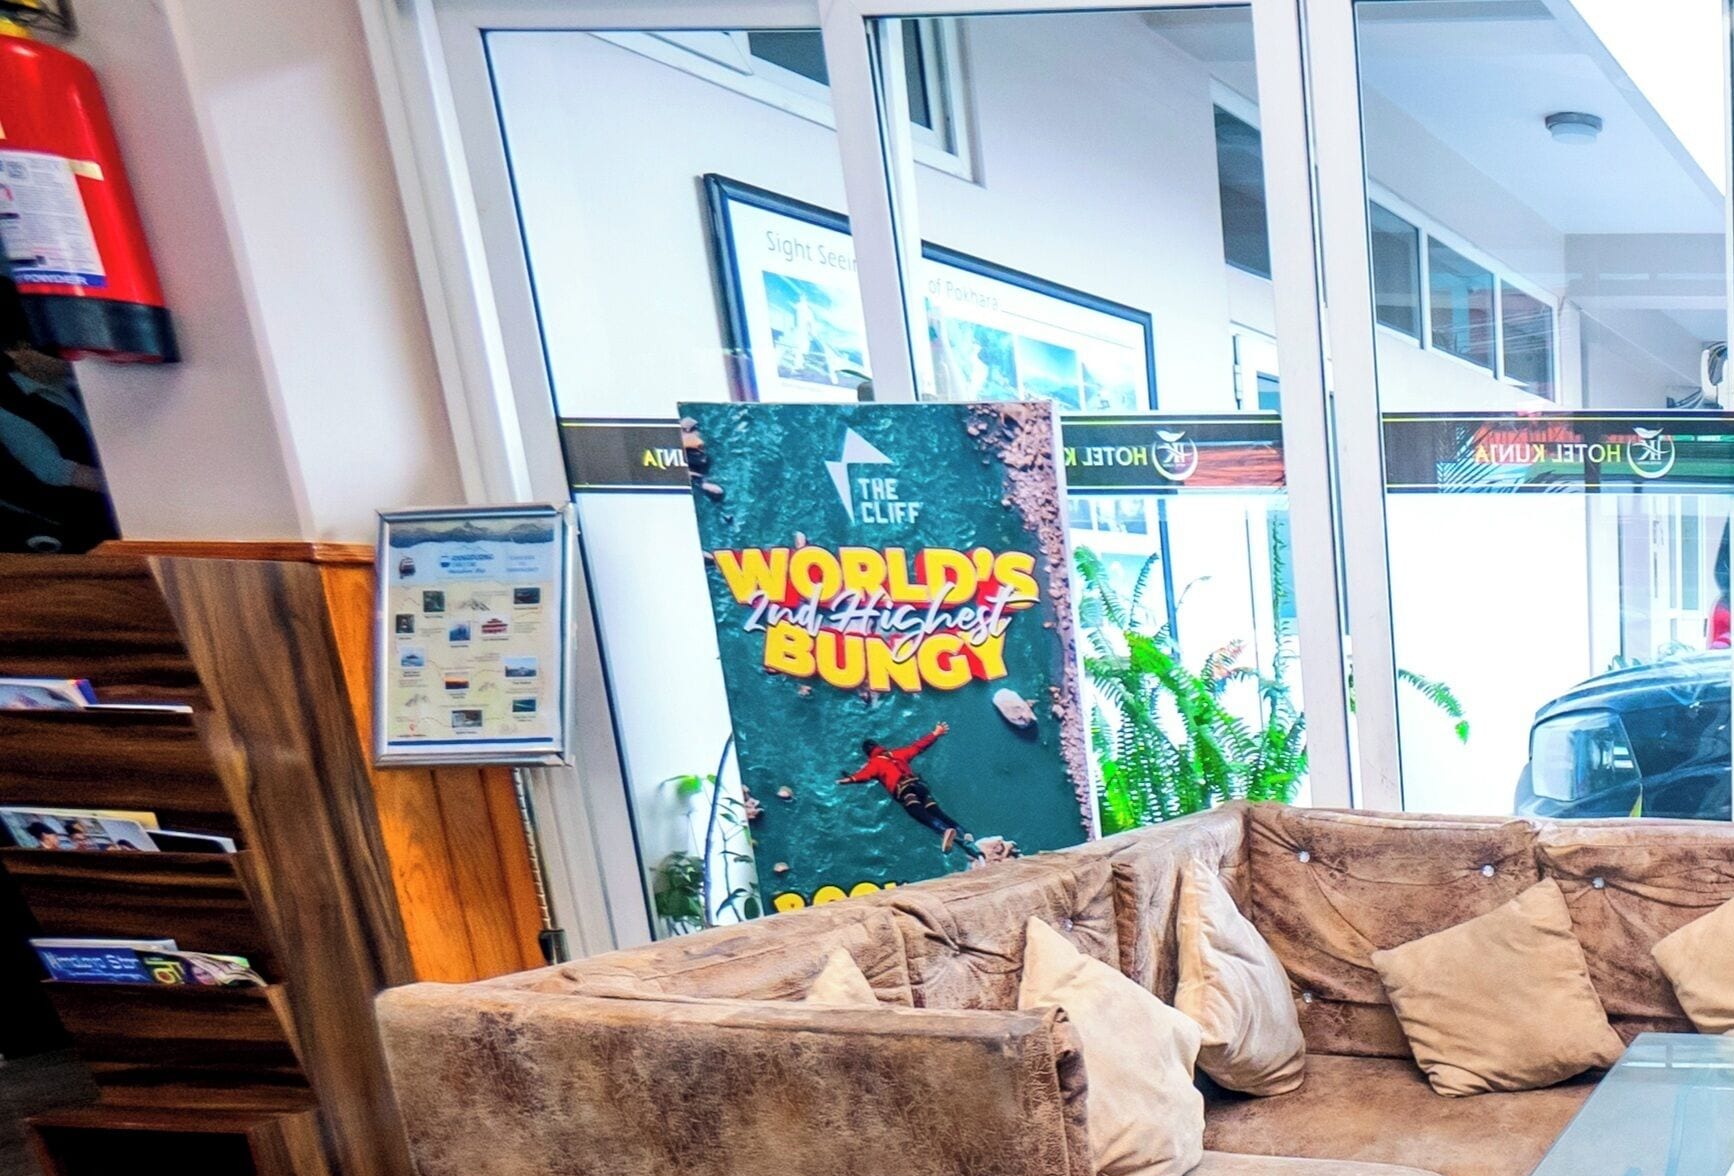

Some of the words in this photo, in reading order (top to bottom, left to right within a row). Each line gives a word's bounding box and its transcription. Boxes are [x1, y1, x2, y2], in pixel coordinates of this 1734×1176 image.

[765, 230, 811, 262] Sight
[816, 244, 858, 273] Seei
[927, 277, 942, 295] of
[945, 281, 999, 311] Pokhara
[858, 477, 899, 500] THE
[861, 501, 923, 523] CLIFF
[713, 546, 1041, 609] WORLD'S
[743, 582, 824, 638] 2nd
[822, 581, 1041, 663] Highest
[763, 618, 1009, 693] BUNGY
